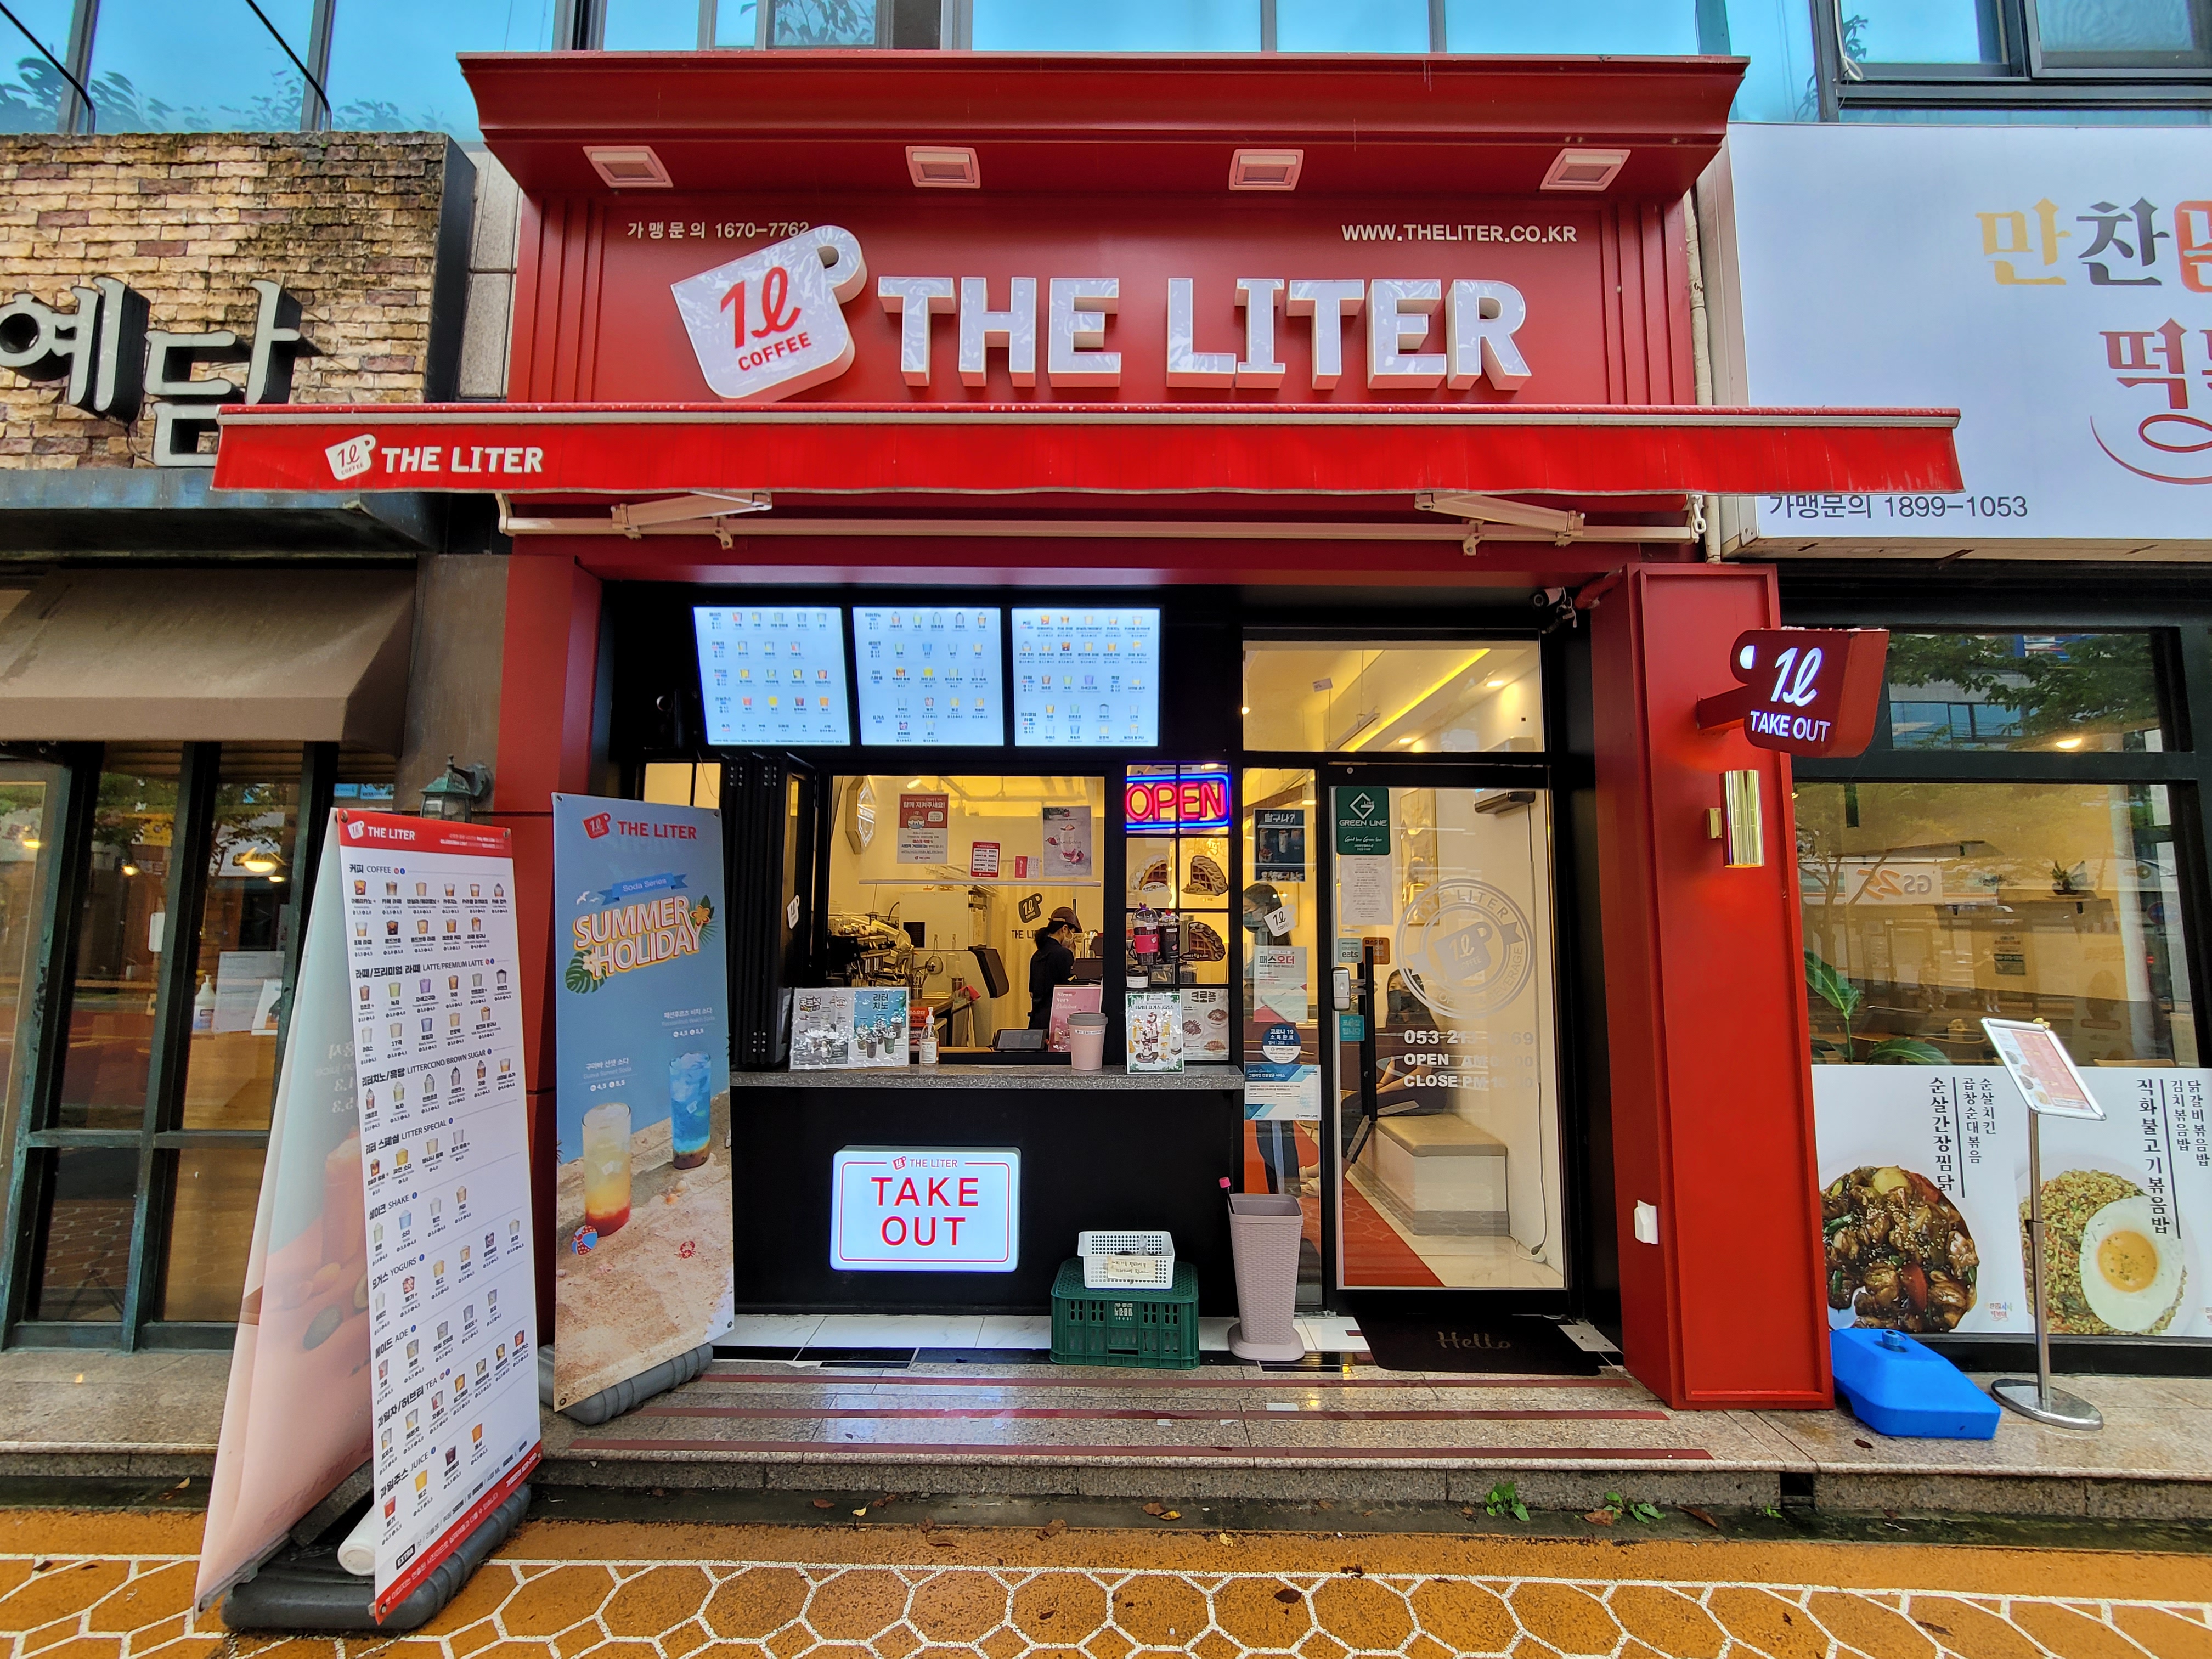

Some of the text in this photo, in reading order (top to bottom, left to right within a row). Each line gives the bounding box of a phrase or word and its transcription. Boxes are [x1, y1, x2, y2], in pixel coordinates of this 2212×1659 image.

[627, 221, 809, 240] 가맹문의 1670-7762
[1341, 224, 1576, 243] WWW.THELITER.CO.KR
[878, 276, 1532, 390] THE LITER
[738, 332, 811, 371] COFFEE
[381, 447, 543, 473] THE LITER
[1768, 495, 2028, 519] 가맹문의 1899-1053
[1750, 711, 1831, 742] TAKE OUT
[1126, 782, 1226, 821] OPEN
[368, 826, 415, 840] THE LITER
[617, 821, 697, 839] THE LITER
[349, 864, 363, 873] 커피
[623, 878, 667, 892] Soda Series
[1457, 889, 1508, 919] LITER
[574, 895, 690, 950] SUMMER
[1011, 930, 1024, 939] THE
[592, 921, 703, 979] HOLIDAY
[1259, 955, 1295, 964] 패스오더
[356, 966, 403, 979] 라떼/프리미엄
[405, 964, 421, 973] 라떼
[423, 961, 467, 971] LATTE/PREMIUM
[1191, 991, 1216, 1003] 크로플
[467, 1049, 486, 1060] SUGAR
[1404, 1054, 1449, 1065] OPEN
[1404, 1075, 1458, 1087] CLOSE
[1962, 1077, 1982, 1164] 곱창순대볶음
[1979, 1077, 1996, 1135] 순살치킨
[2170, 1080, 2191, 1152] 김치볶음밥
[366, 1120, 447, 1154] 리터 스페셜 LITTER SPECIAL
[1929, 1077, 1955, 1192] 순살간장찜닭
[2187, 1080, 2210, 1167] 닭갈비볶음밥
[910, 1159, 957, 1167] THE LITER
[2137, 1079, 2170, 1234] 직화불고기볶음밥
[388, 1194, 409, 1209] SHAKE
[871, 1177, 979, 1206] TAKE
[881, 1216, 966, 1246] OUT
[373, 1259, 416, 1290] 요거스 YOGURS
[375, 1329, 409, 1358] 에이드 ADE
[1436, 1331, 1511, 1349] Hello
[378, 1379, 438, 1429] 과일차/허브티 TEA
[380, 1451, 429, 1499] 과일주스 JUICE
